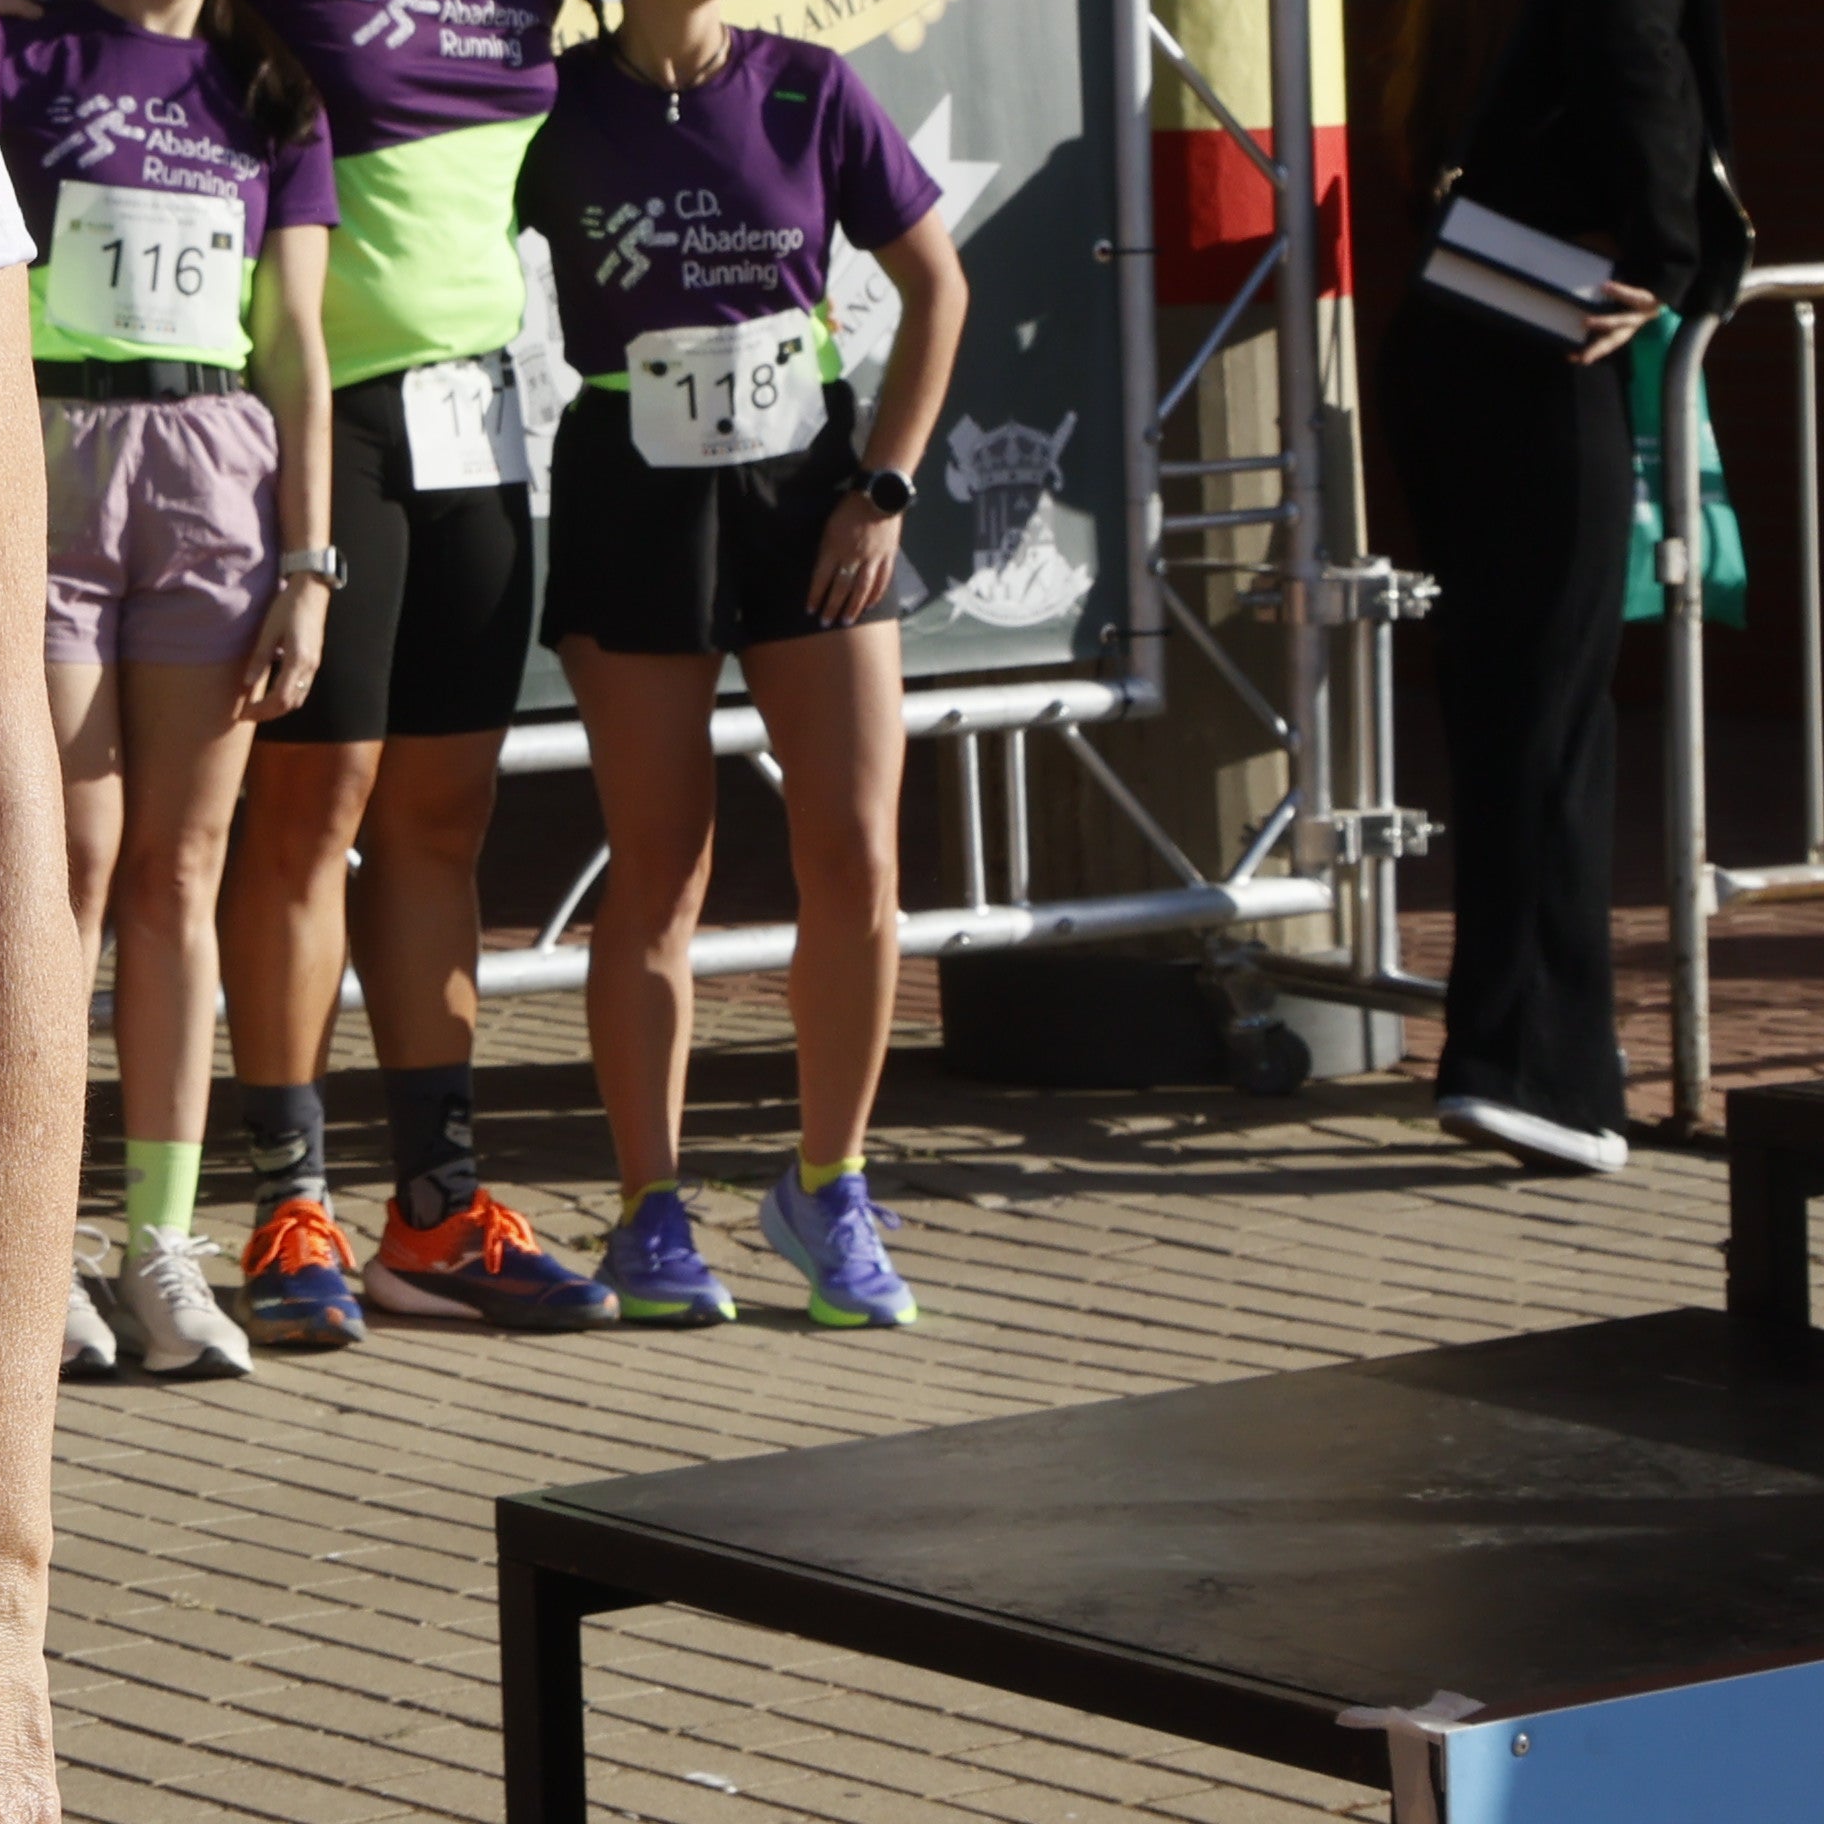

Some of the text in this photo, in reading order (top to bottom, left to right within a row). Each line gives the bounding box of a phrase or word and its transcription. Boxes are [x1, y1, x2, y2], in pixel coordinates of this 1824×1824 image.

[438, 27, 523, 66] Running
[675, 189, 722, 220] C.D.
[681, 222, 804, 258] Abadengo
[102, 238, 205, 296] 116
[681, 260, 779, 290] Running
[676, 364, 778, 420] 118
